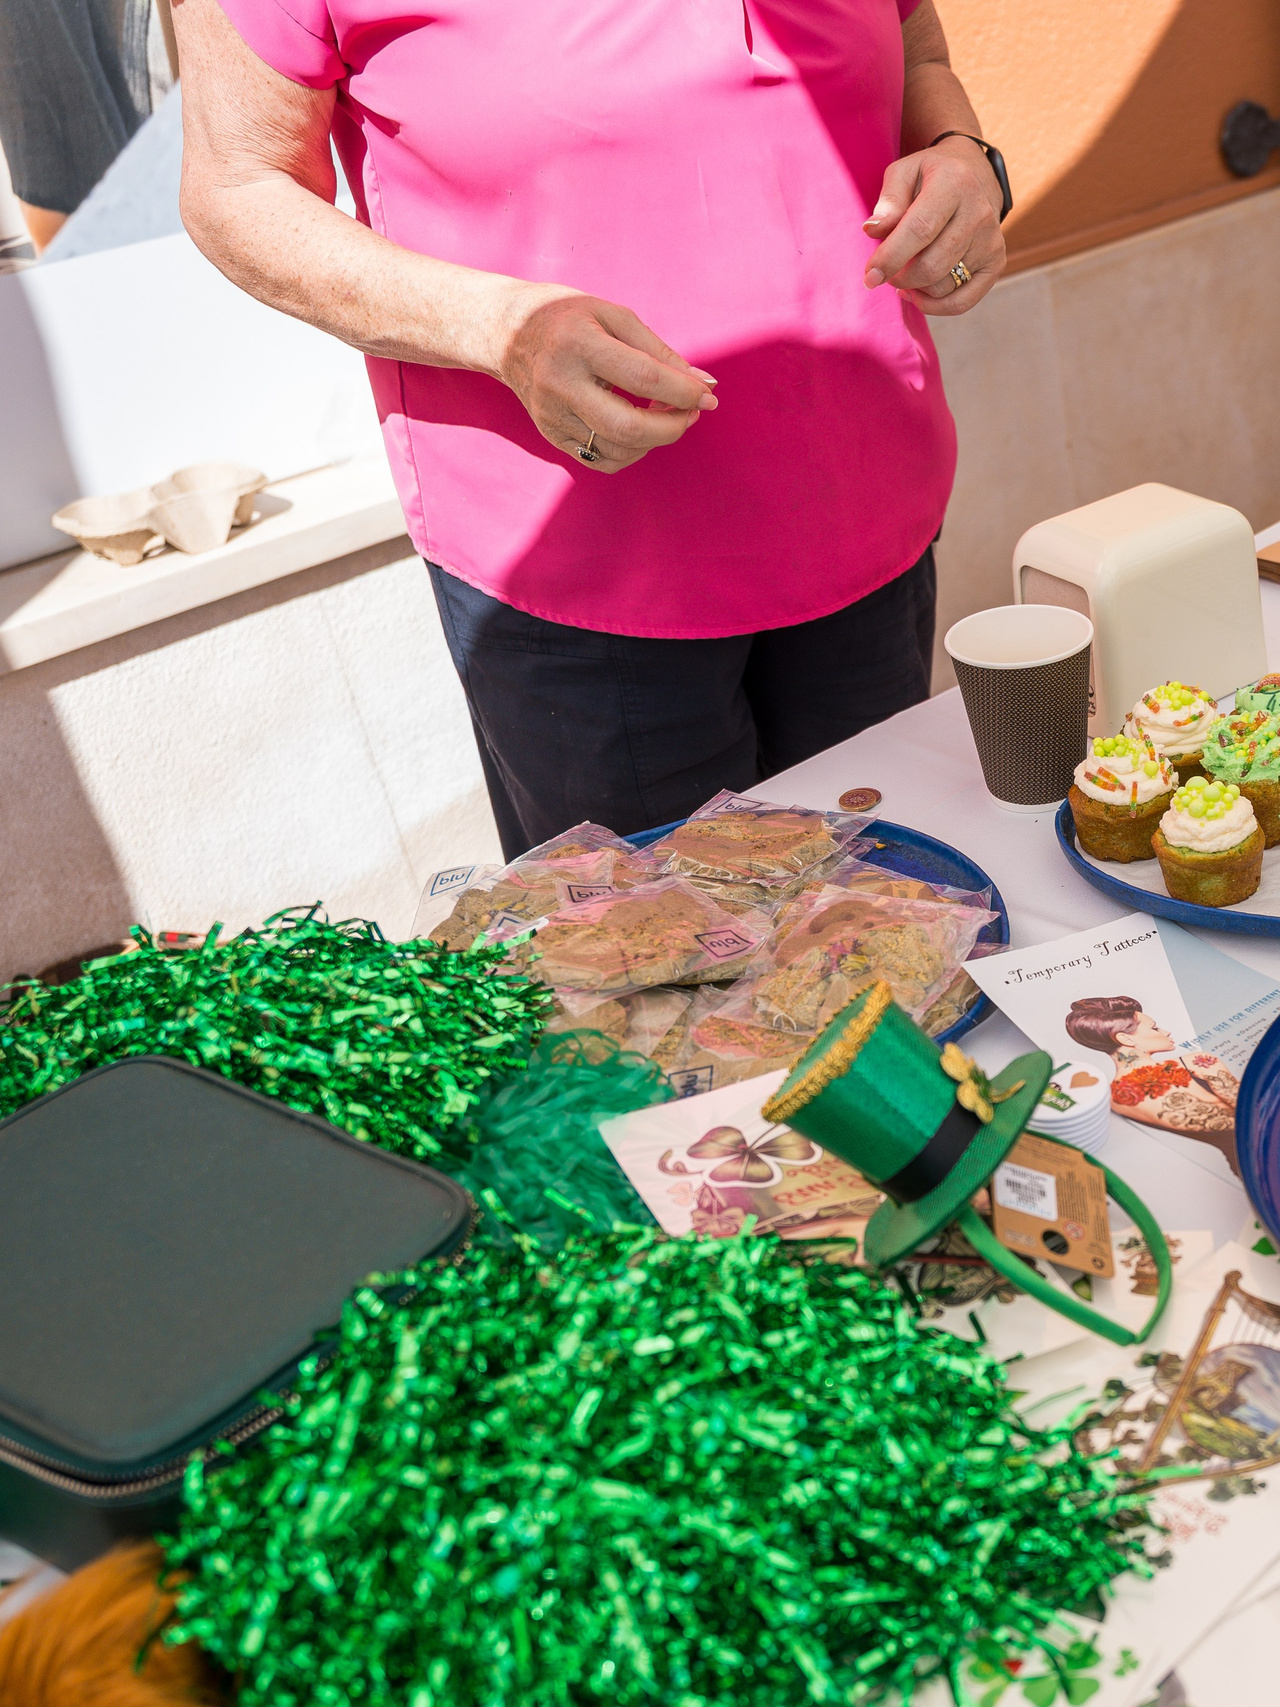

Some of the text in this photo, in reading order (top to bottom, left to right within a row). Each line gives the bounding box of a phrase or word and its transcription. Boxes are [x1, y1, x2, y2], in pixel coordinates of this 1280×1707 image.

[439, 873, 465, 885] blu
[709, 937, 741, 948] blu
[1008, 932, 1152, 984] Temporary Tattoos
[1179, 1030, 1213, 1050] WIDELY
[1213, 1021, 1229, 1032] USE
[1229, 1012, 1245, 1023] FOR
[1240, 1018, 1266, 1035] Dancing
[1214, 1039, 1231, 1050] Party
[1223, 1044, 1239, 1055] Club
[677, 1074, 698, 1100] blu
